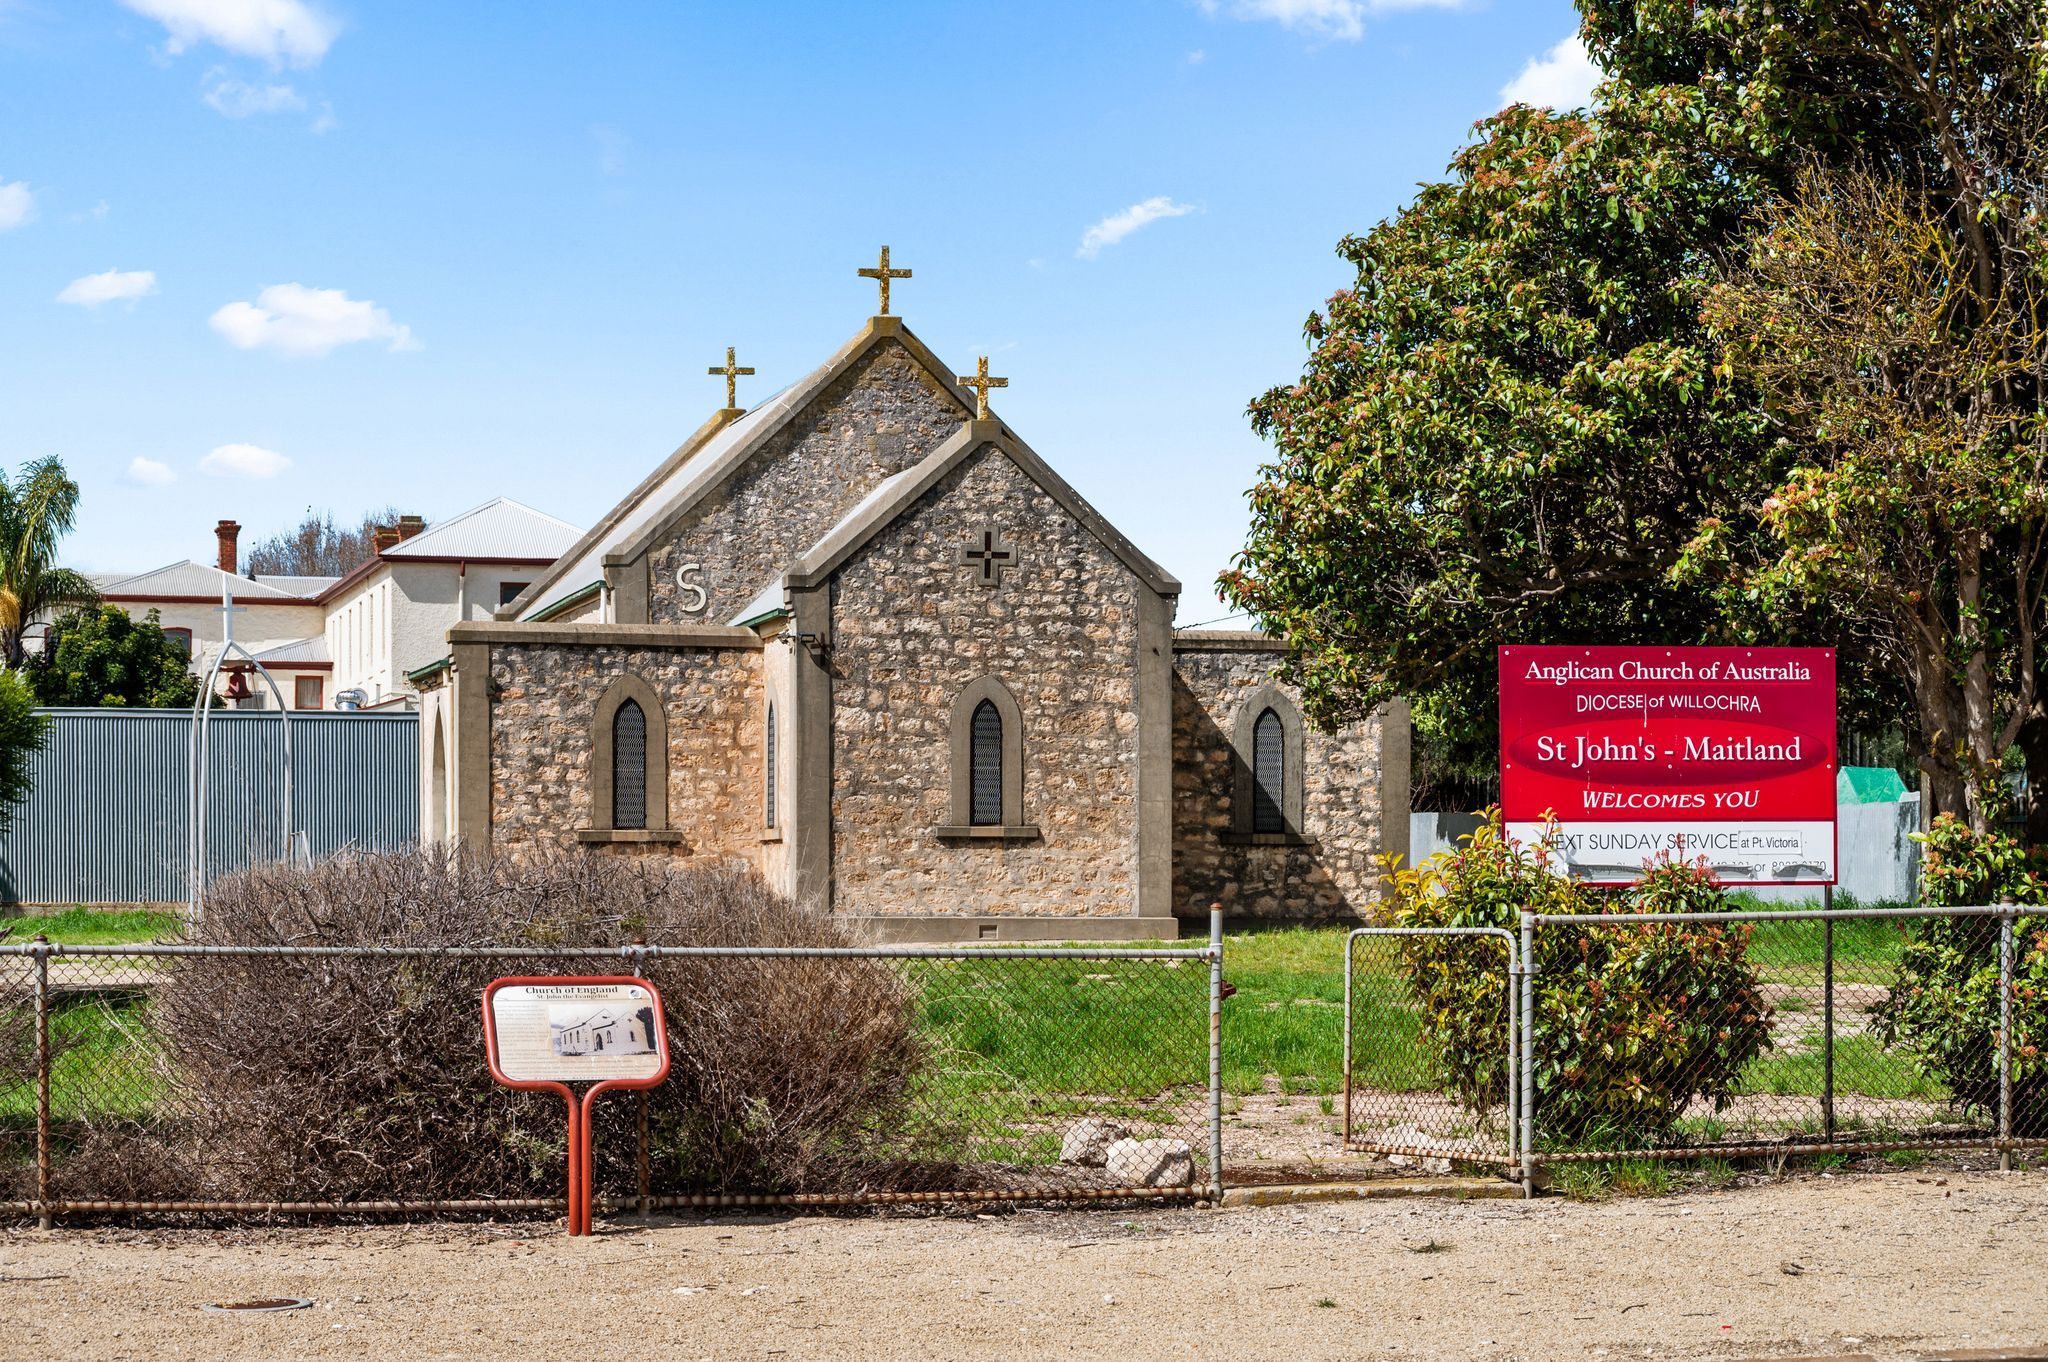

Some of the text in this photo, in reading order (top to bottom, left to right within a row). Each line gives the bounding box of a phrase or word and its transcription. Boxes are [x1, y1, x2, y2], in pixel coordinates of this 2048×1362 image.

[1525, 661, 1811, 686] Anglican Church of Australia
[1576, 694, 1762, 713] DIOCESE of WILLOCHRA
[1537, 736, 1567, 761] St
[1571, 736, 1656, 768] John's
[1682, 736, 1802, 761] Maitland
[1583, 790, 1760, 809] WELCOMES YOU
[1589, 833, 1662, 850] SUNDAY
[1667, 833, 1738, 850] SRVICE
[1740, 838, 1750, 849] at
[1766, 836, 1799, 849] Victoria
[525, 986, 619, 995] Church of England
